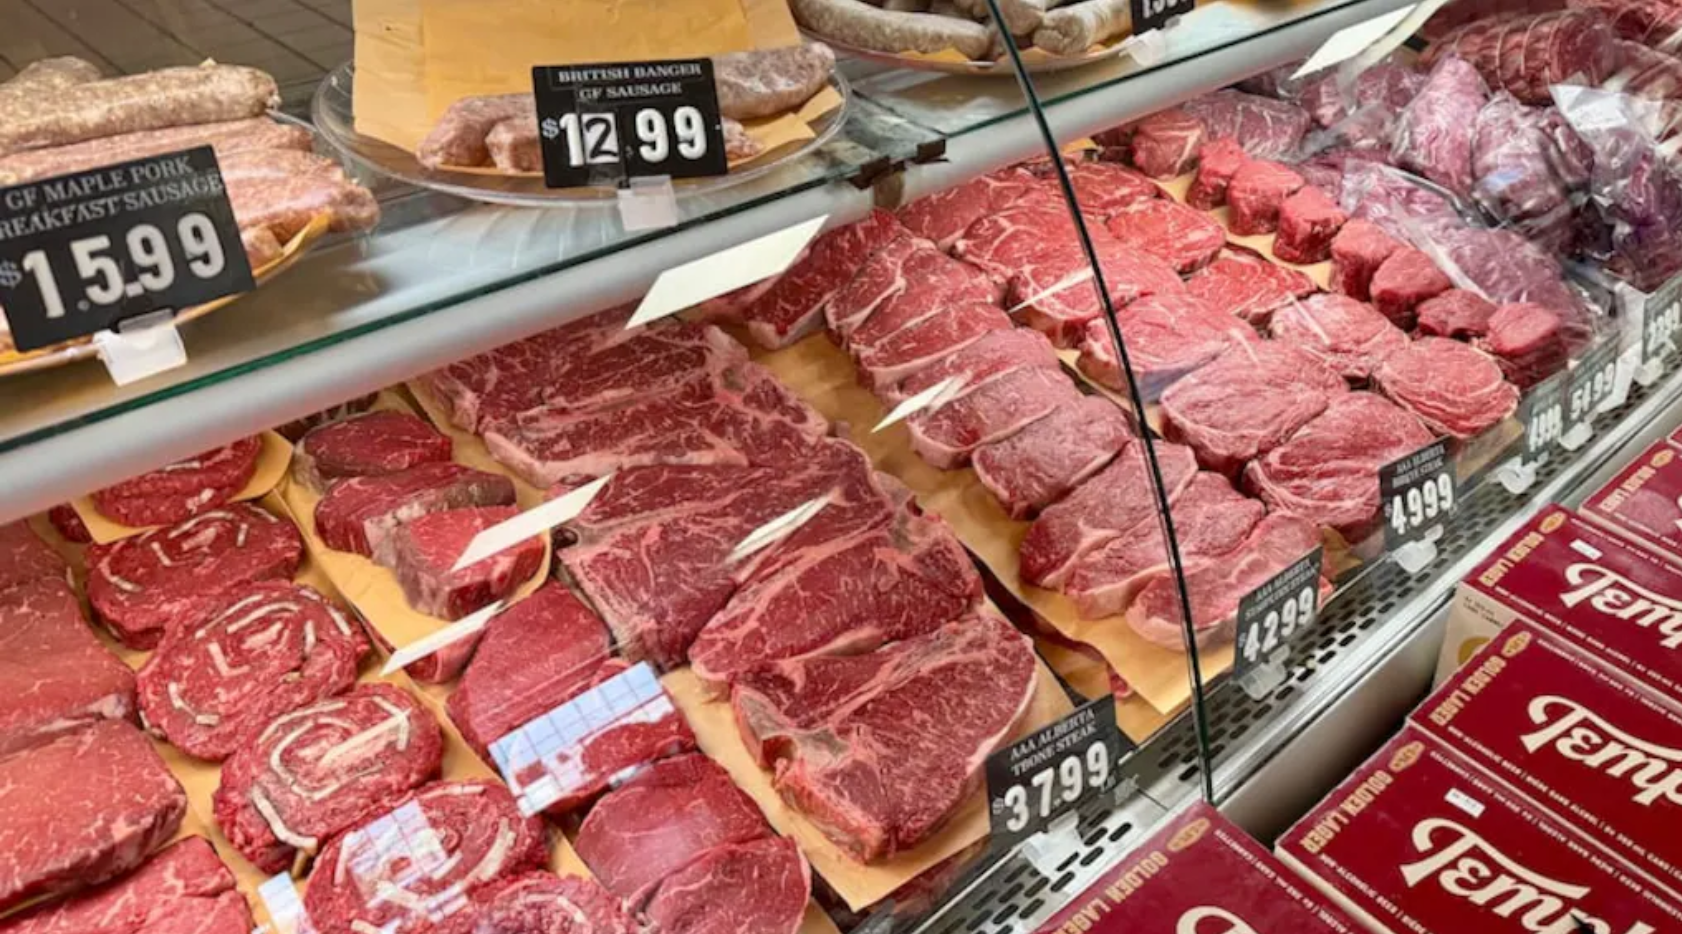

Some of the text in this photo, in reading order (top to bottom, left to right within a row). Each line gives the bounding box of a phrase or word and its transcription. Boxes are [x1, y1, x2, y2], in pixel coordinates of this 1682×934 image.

[558, 63, 701, 83] BRITISH BANGER
[579, 82, 683, 100] GF SAUSAGE
[0, 172, 224, 239] REAKFAST SAUSAGE
[6, 156, 193, 210] GF MAPLE PORK
[1428, 654, 1507, 727] GOLDEN LAGER
[1010, 708, 1095, 761] AAA ALBERTA
[1012, 721, 1097, 776] TBONE STEAK
[1299, 769, 1394, 854] GOLDEN LAGER
[1105, 851, 1169, 904] GOLDEN
